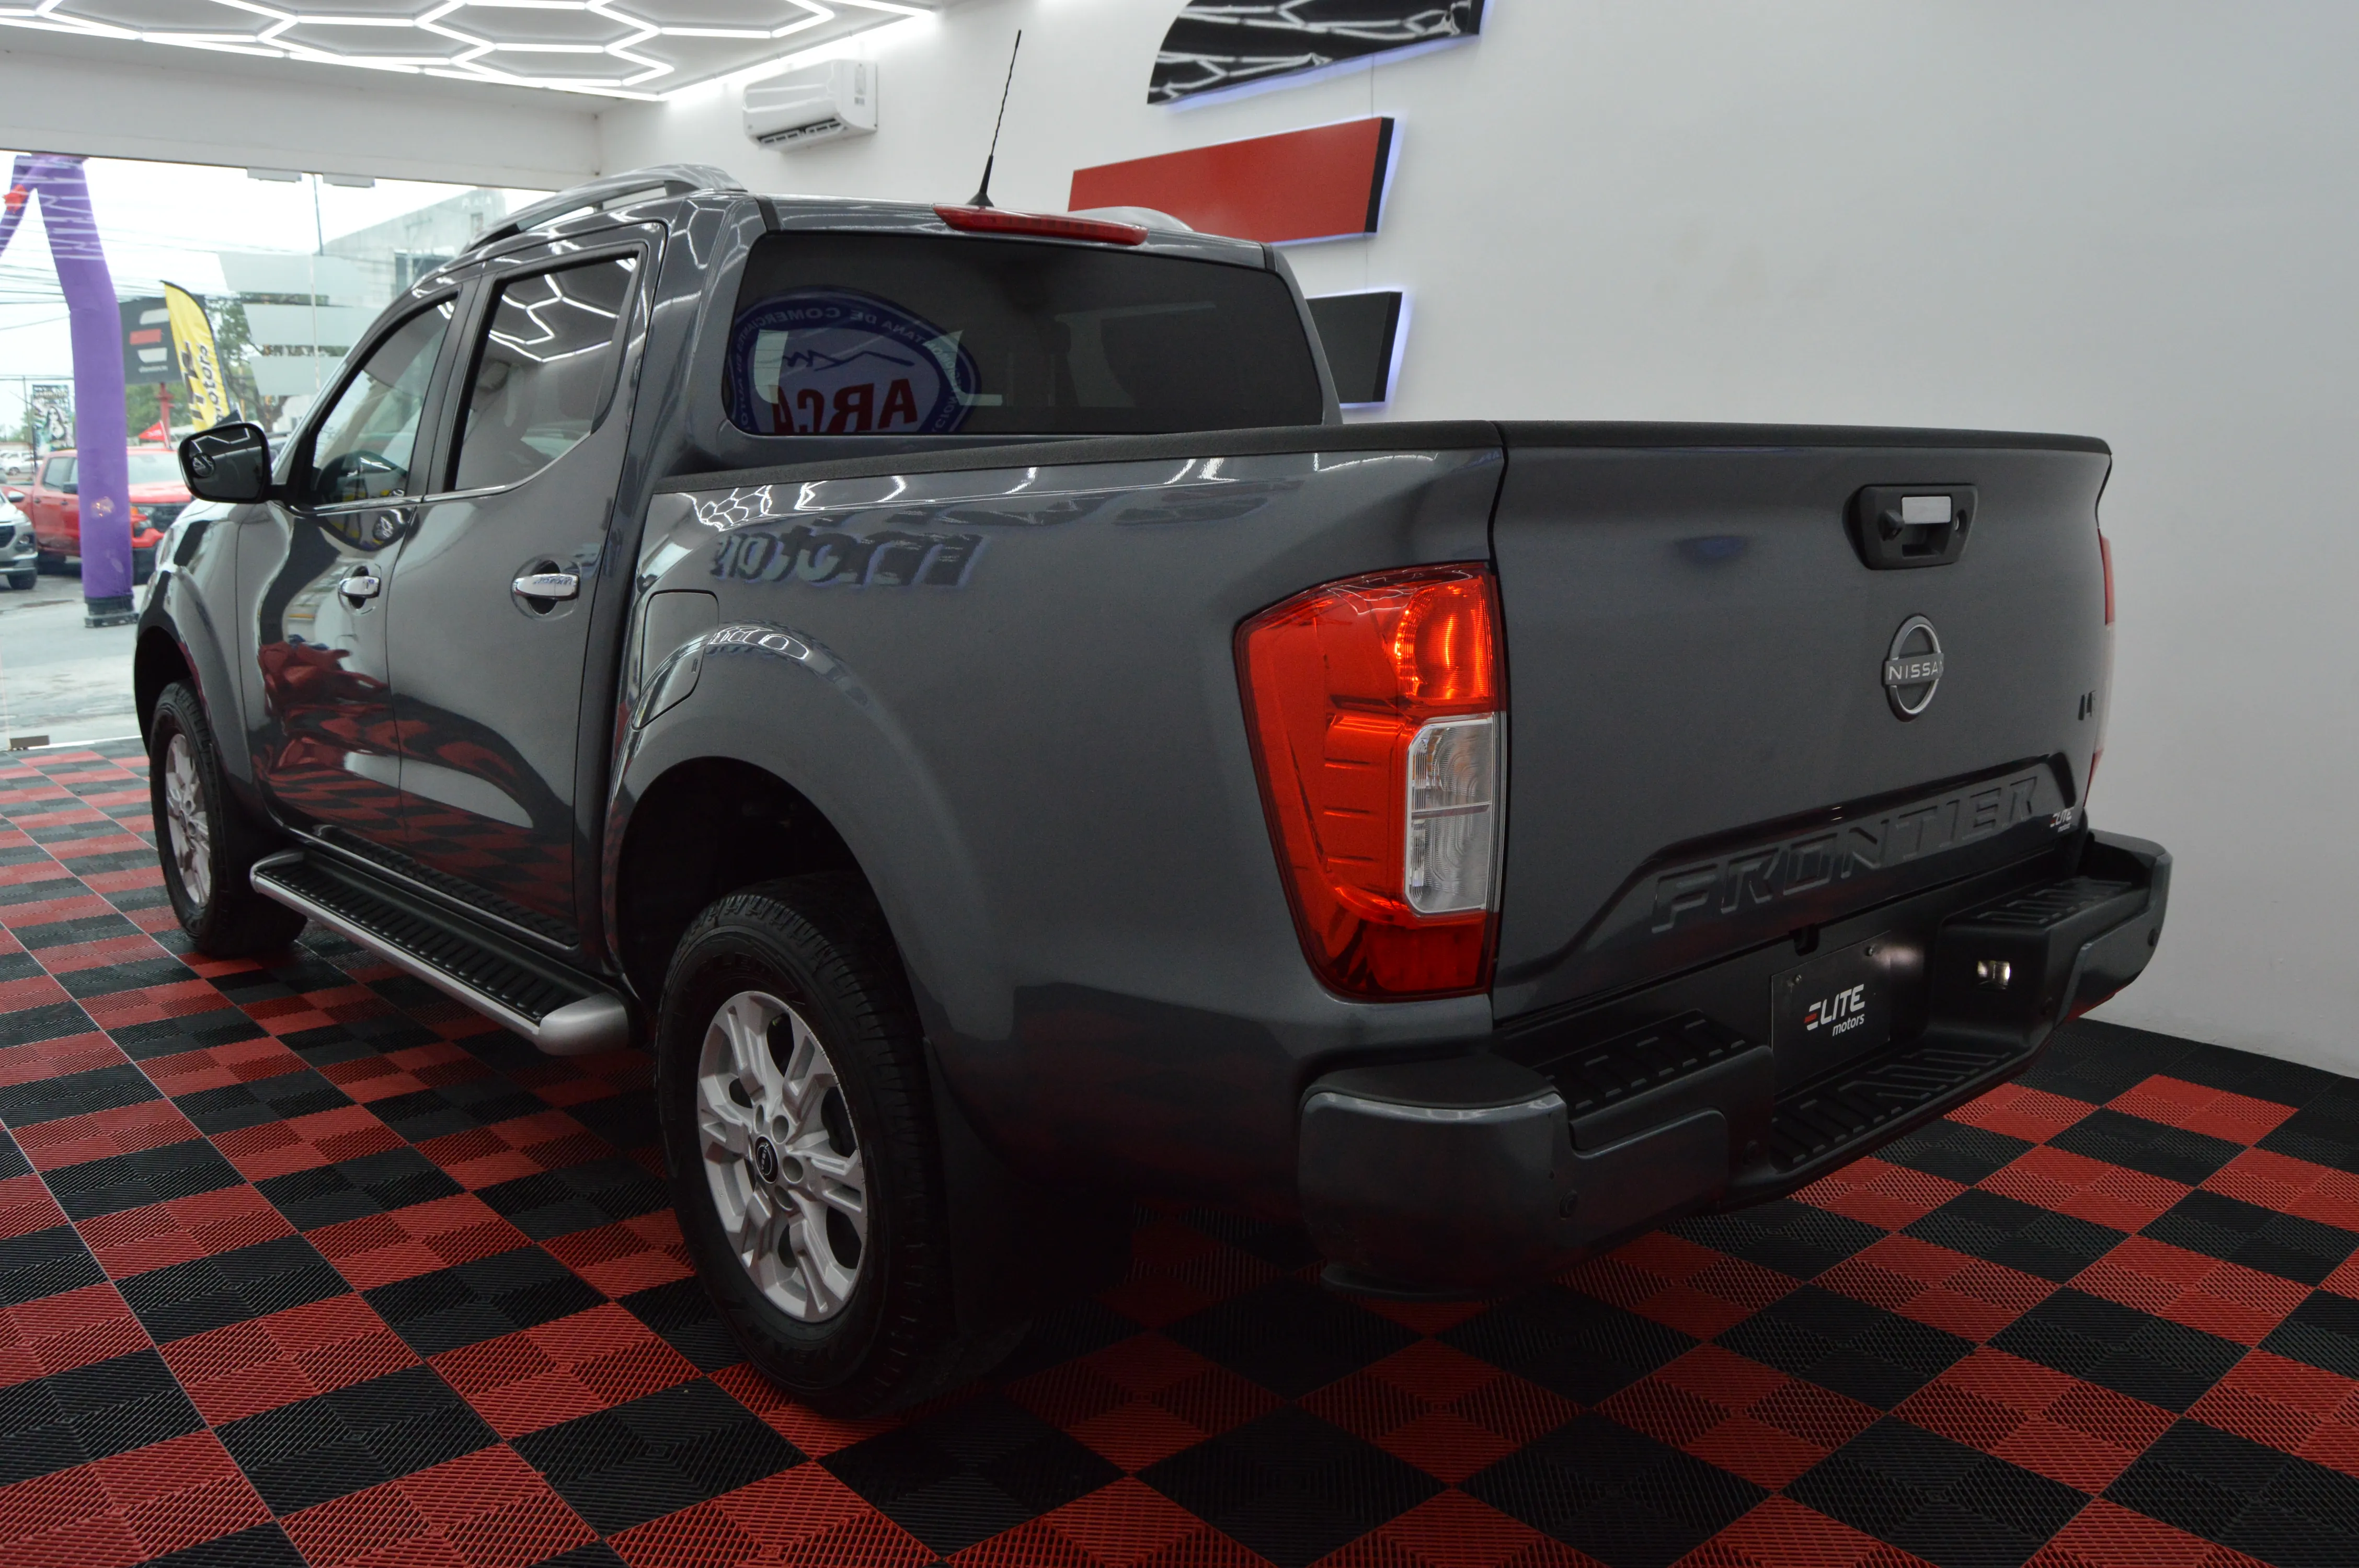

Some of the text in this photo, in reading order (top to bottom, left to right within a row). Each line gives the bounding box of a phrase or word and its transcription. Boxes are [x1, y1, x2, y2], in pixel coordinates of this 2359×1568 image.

[2049, 806, 2075, 828] ELITE
[1651, 776, 2039, 934] FRONTIER
[1803, 983, 1865, 1031] ELITE
[1832, 1013, 1865, 1037] motors
